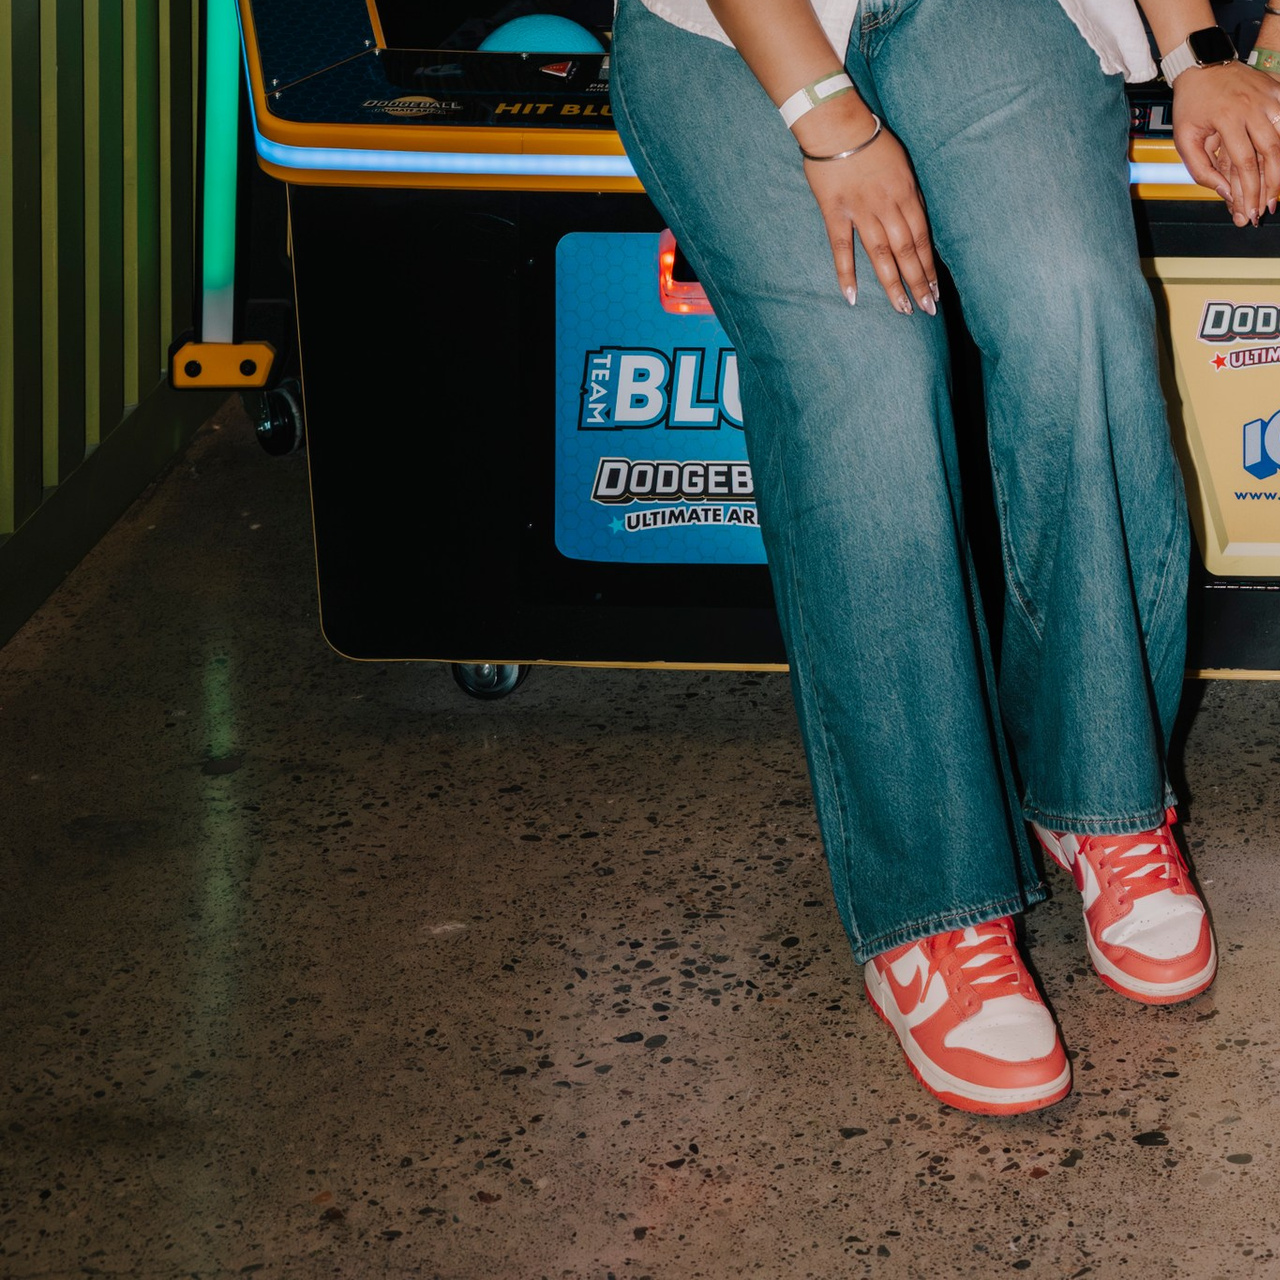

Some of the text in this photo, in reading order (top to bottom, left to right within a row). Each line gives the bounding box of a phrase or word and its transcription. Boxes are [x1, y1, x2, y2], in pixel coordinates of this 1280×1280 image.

[362, 98, 464, 110] DODGEBALL
[494, 102, 614, 117] HIT BLU
[586, 353, 612, 424] TEAM
[596, 461, 755, 497] DODGEB
[626, 507, 722, 531] ULTIMATE
